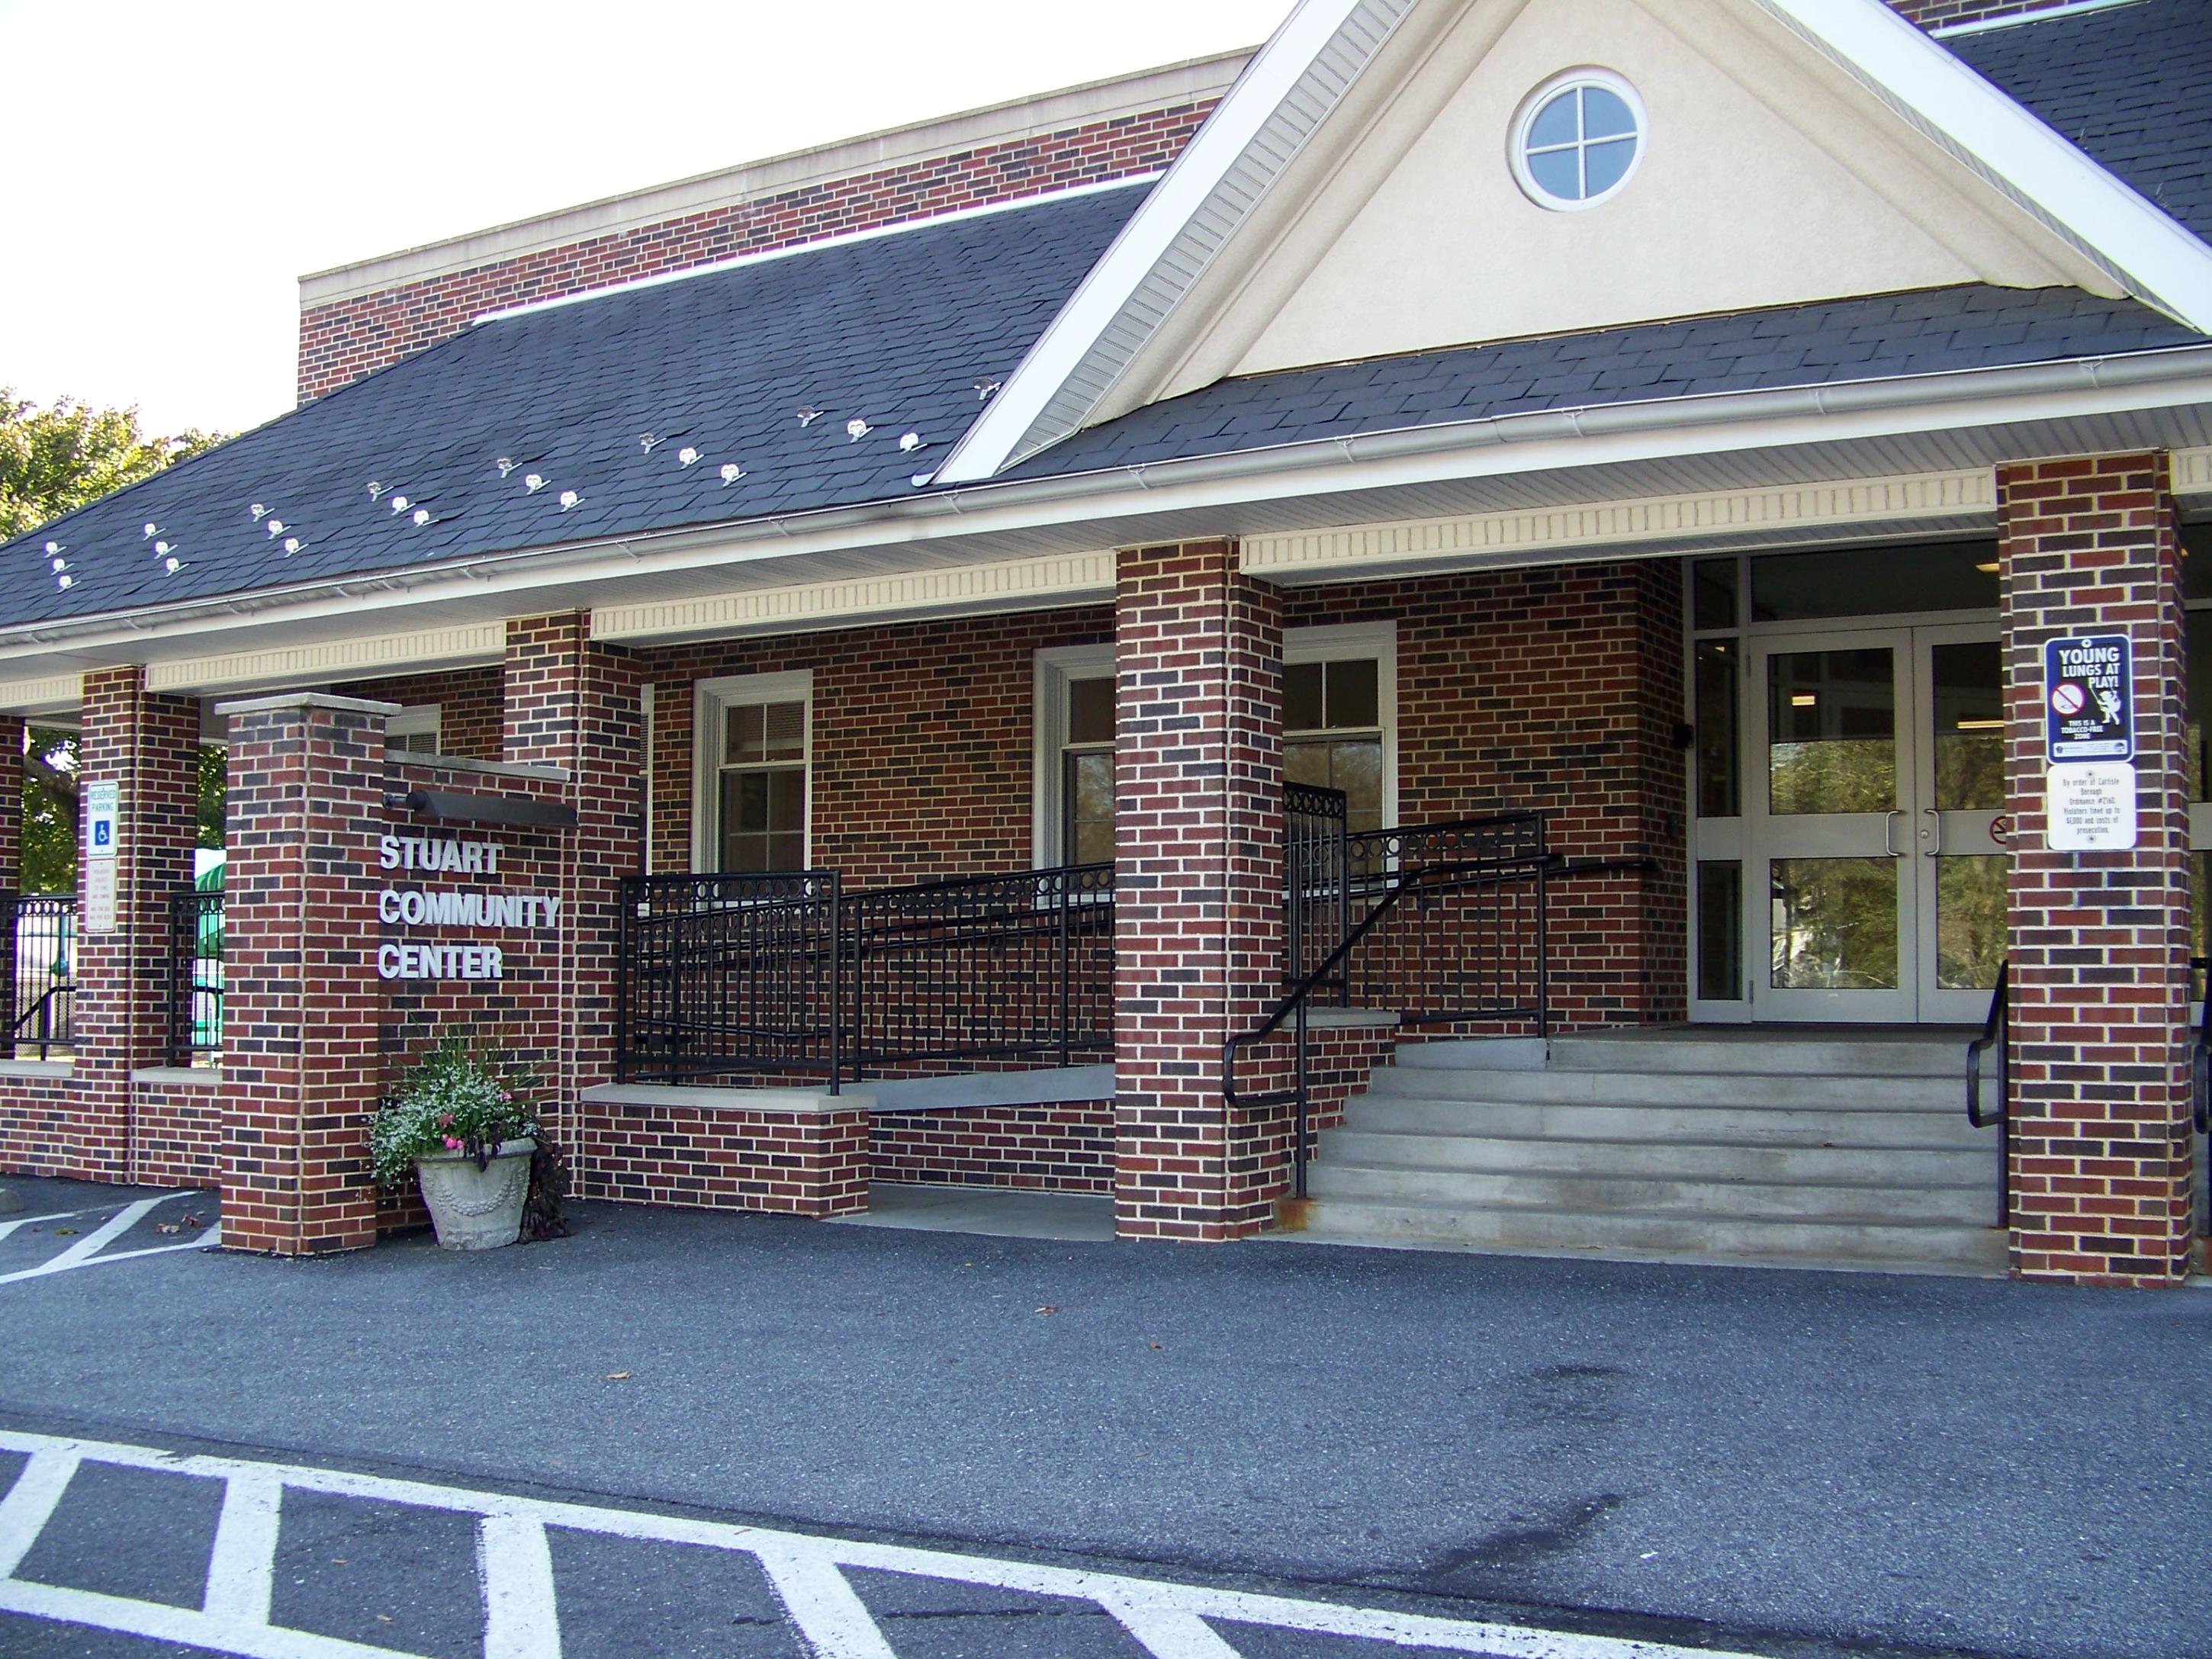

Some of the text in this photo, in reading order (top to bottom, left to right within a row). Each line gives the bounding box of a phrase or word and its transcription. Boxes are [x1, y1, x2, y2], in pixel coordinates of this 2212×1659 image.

[2059, 647, 2120, 664] YOUNG
[2062, 663, 2120, 677] LUNGS AT
[2088, 676, 2118, 689] PLAY!
[2061, 725, 2104, 734] TOBACCO-FREE
[2062, 779, 2070, 788] By
[89, 789, 116, 799] RESERVED
[92, 802, 114, 812] PARKING
[381, 835, 503, 874] STUART
[380, 889, 561, 928] COMMUNITY
[378, 944, 503, 979] CENTER
